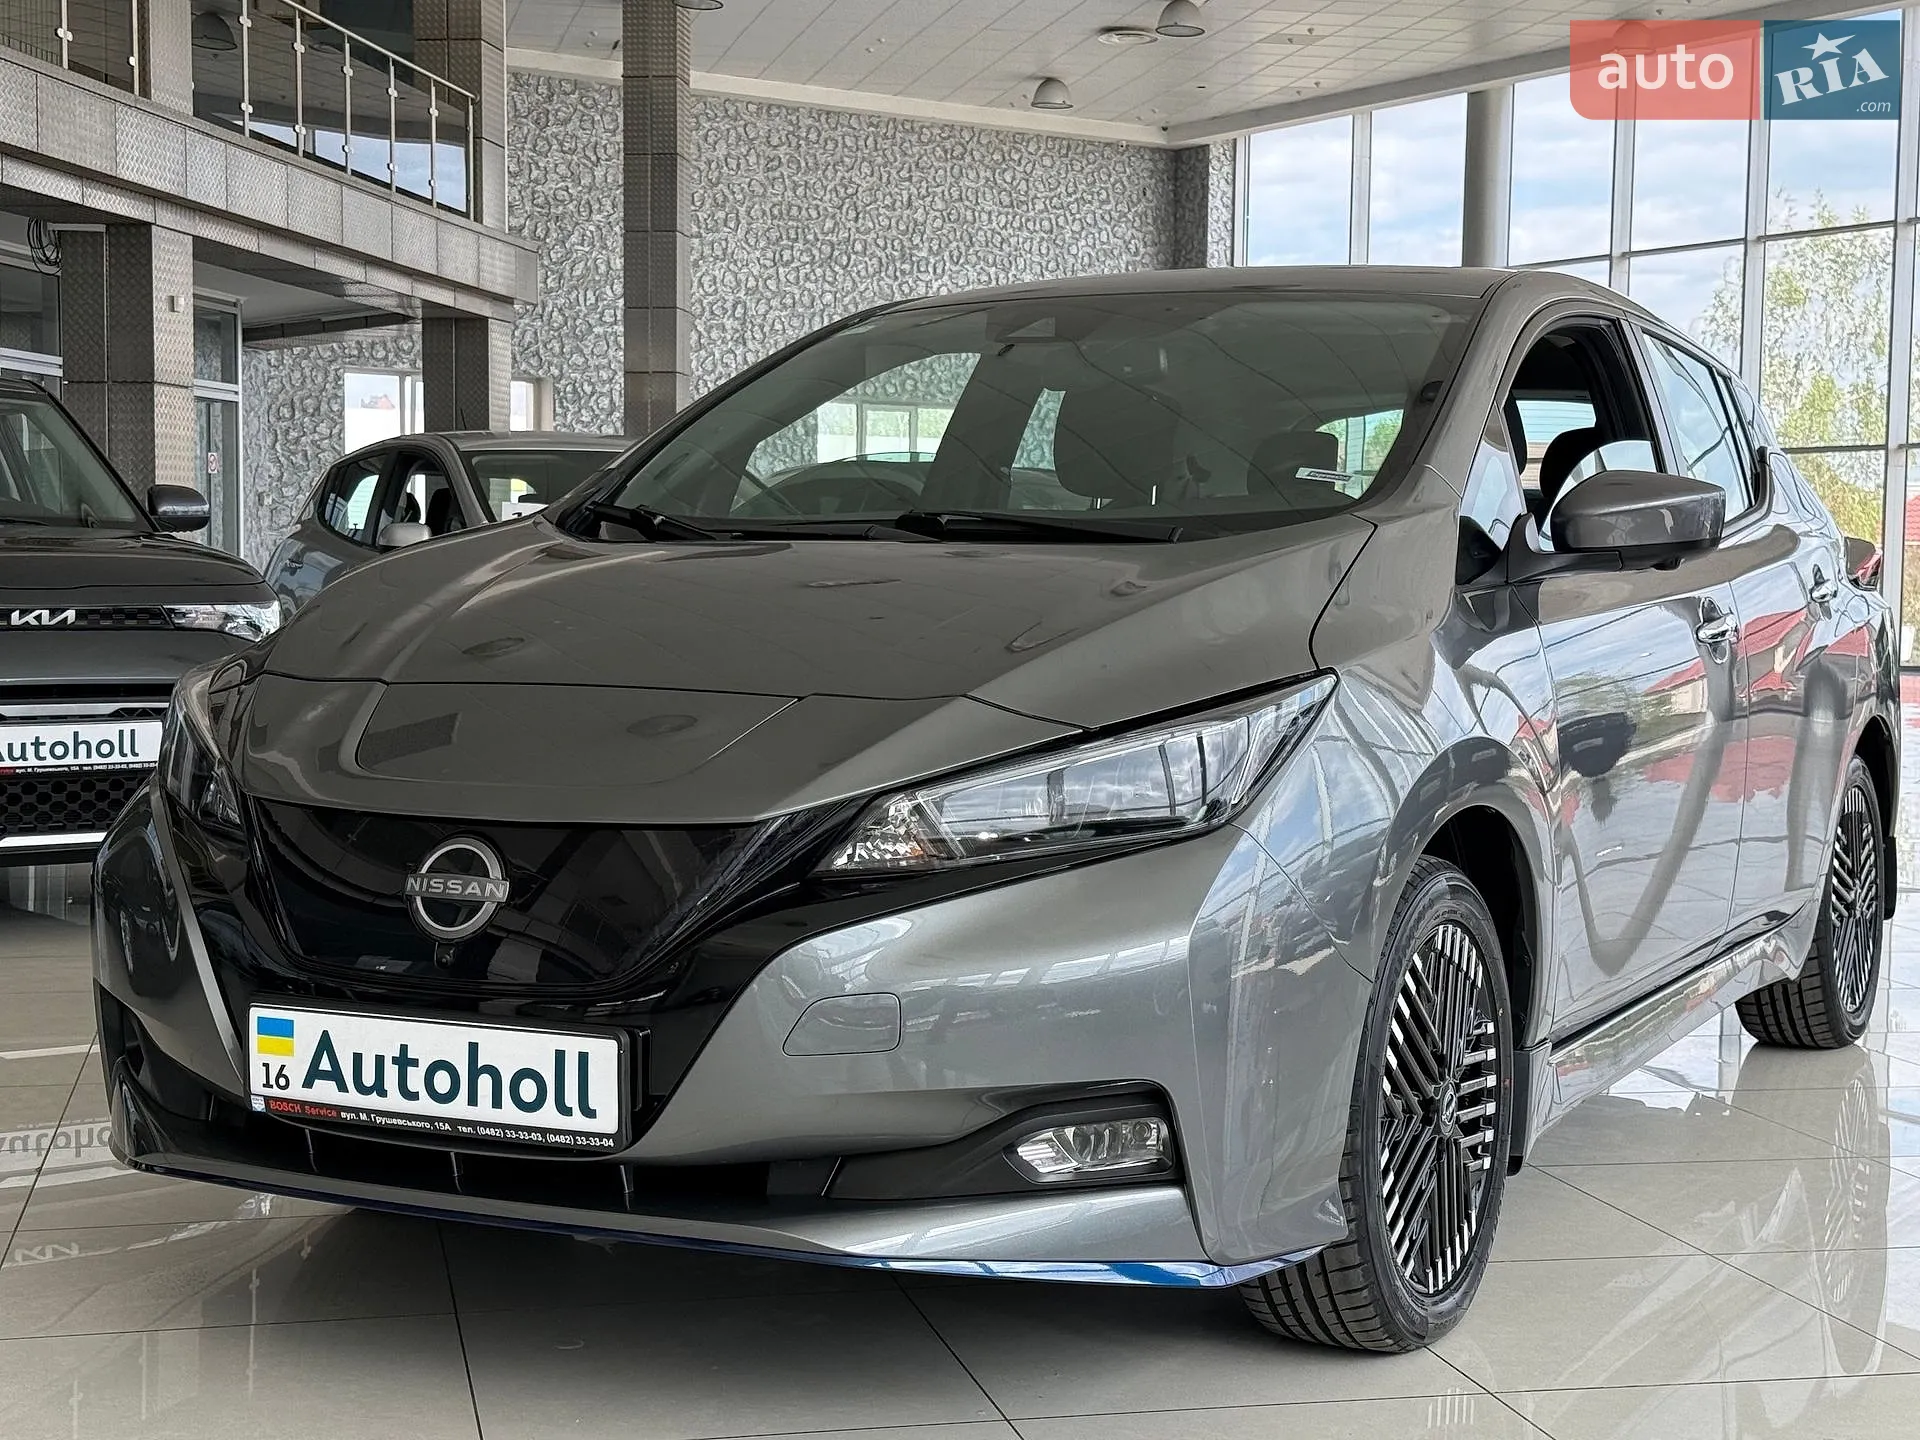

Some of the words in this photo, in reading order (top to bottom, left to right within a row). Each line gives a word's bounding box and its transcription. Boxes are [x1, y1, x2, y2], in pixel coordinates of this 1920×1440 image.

[10, 608, 76, 626] KIA
[0, 728, 140, 762] utoholl
[406, 876, 505, 899] NISSAN
[261, 1062, 291, 1091] 16
[301, 1029, 598, 1120] Autoholl
[268, 1100, 301, 1113] BOSCH
[304, 1105, 337, 1118] Service
[340, 1111, 359, 1121] вул.
[359, 1112, 370, 1122] М.
[456, 1124, 476, 1134] тел.
[477, 1125, 504, 1138] (0482)
[505, 1130, 545, 1143] 33-33-03,
[546, 1133, 574, 1146] (0482)
[575, 1136, 615, 1148] 33-33-04
